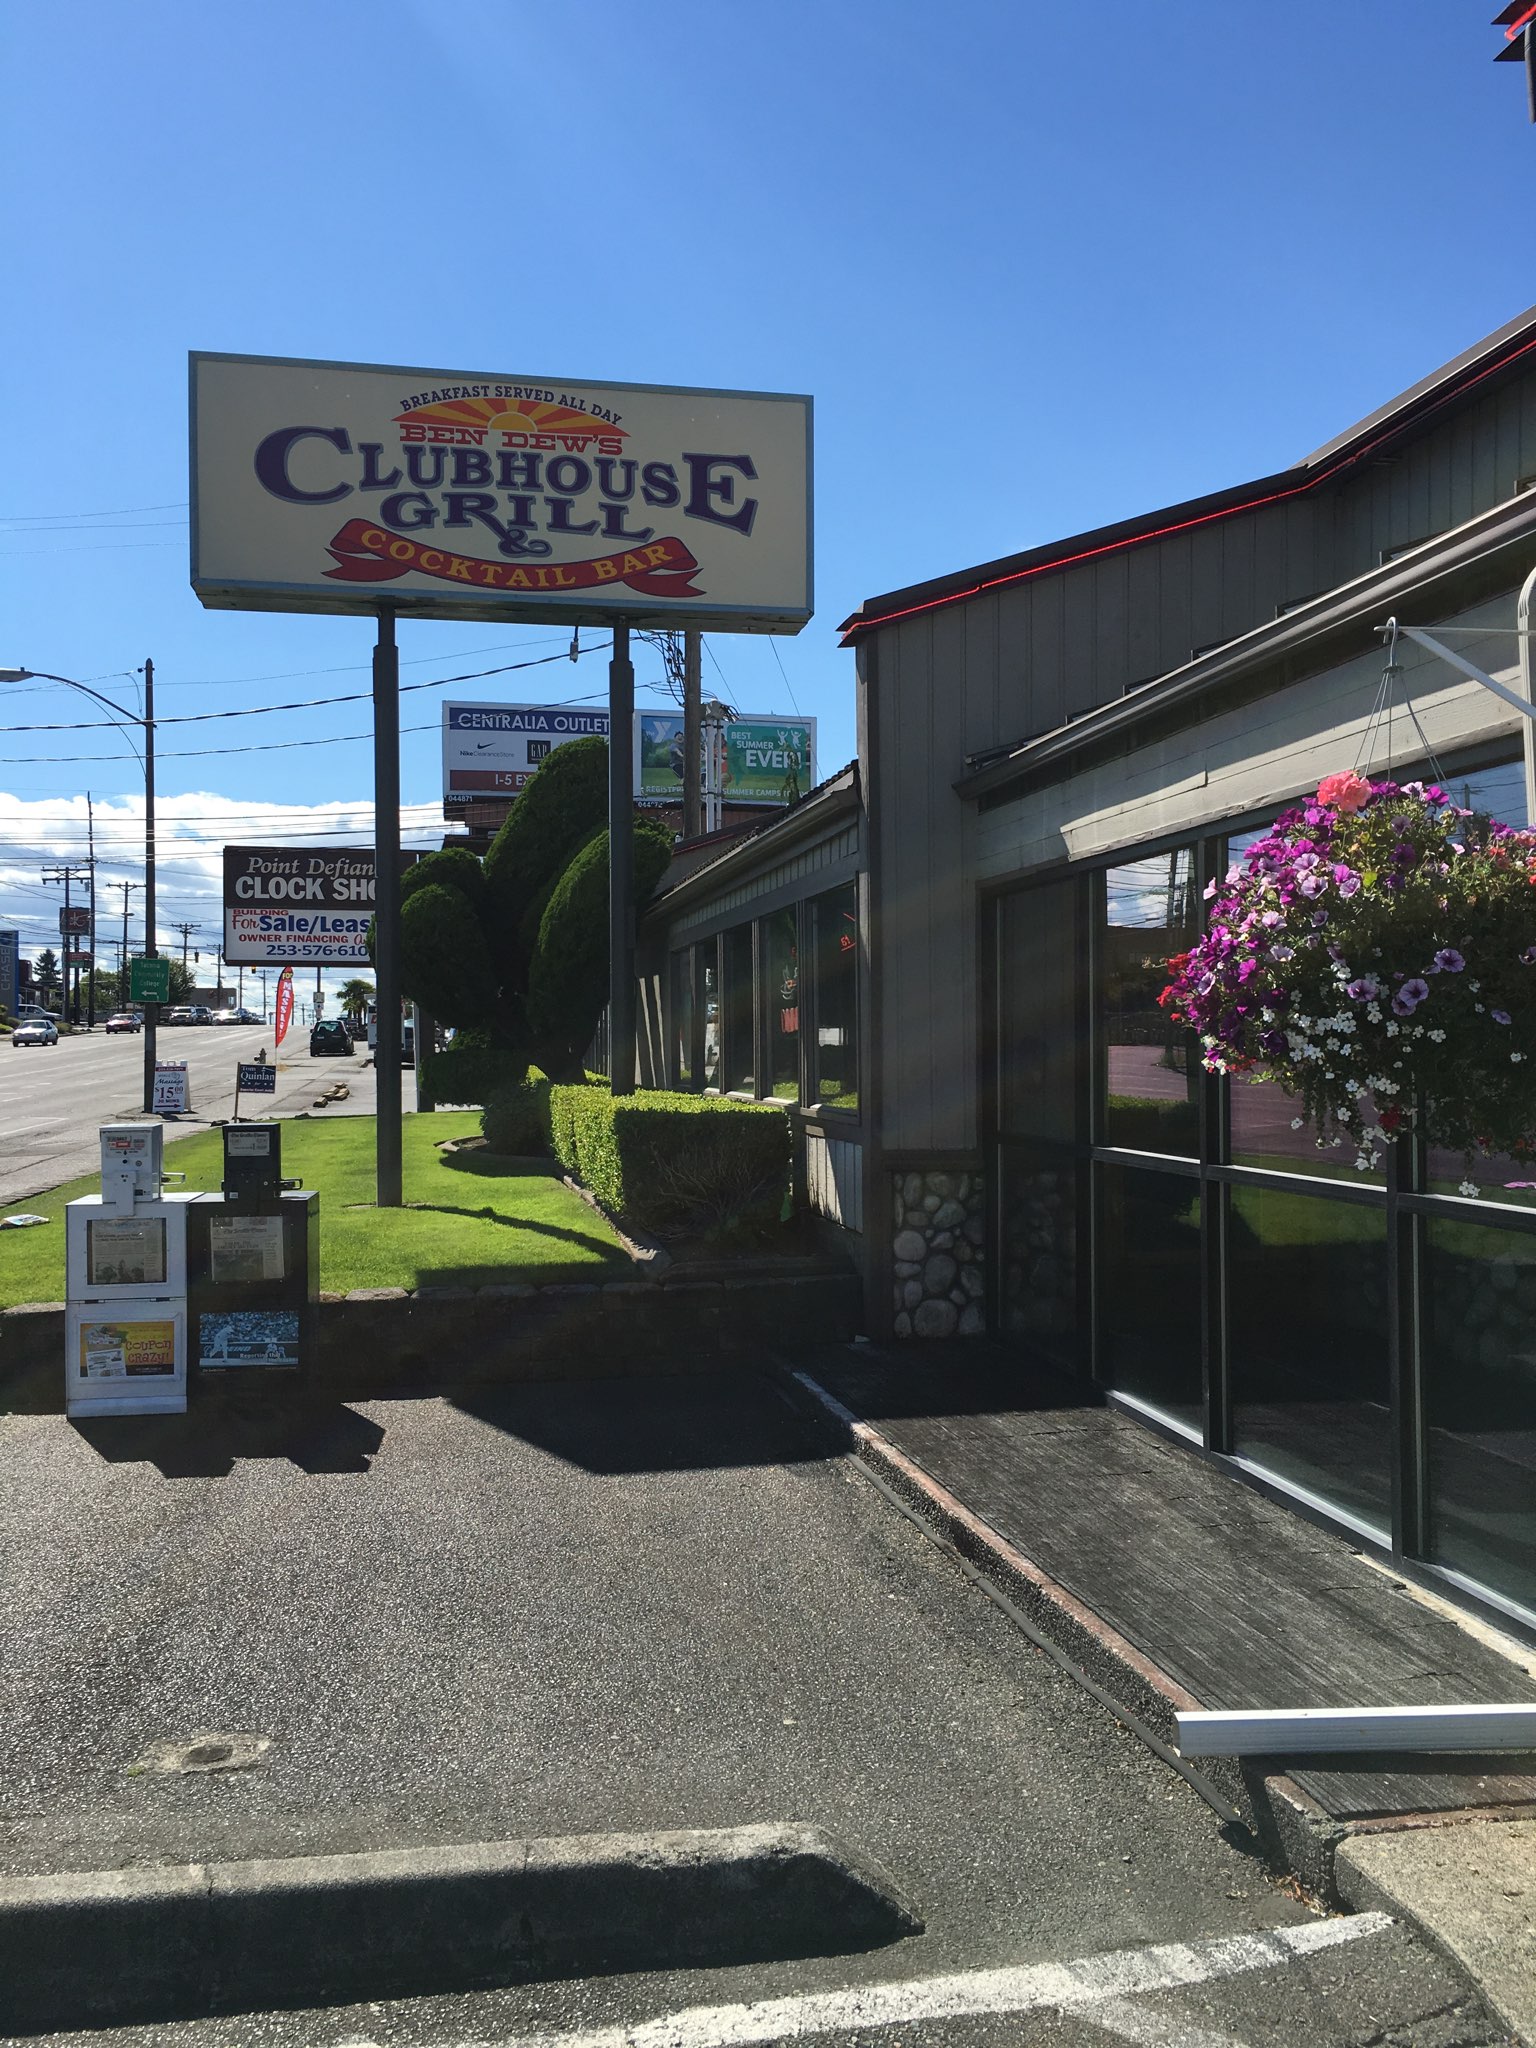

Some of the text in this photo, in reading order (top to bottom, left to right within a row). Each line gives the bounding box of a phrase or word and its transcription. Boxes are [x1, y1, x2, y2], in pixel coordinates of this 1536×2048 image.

[400, 385, 622, 426] BREAKFAST SERVED ALL DAY
[400, 423, 623, 456] BEN DEW'S
[253, 425, 759, 537] CLUBHOUSE
[380, 491, 655, 544] GRILL
[497, 528, 553, 558] &
[360, 528, 674, 588] COCKTAIL BAR
[458, 712, 609, 732] CENTRALIA OUTLET
[731, 731, 752, 740] BEST
[736, 740, 774, 750] SUMMER
[530, 743, 548, 758] GAP
[495, 773, 532, 786] I-5 EX
[723, 787, 755, 796] SUMMER
[756, 789, 781, 797] CAMPS
[246, 856, 375, 880] Point Defian
[235, 875, 376, 901] CLOCK SH
[231, 914, 371, 935] For Sale/Leas
[238, 933, 282, 943] OWNER
[286, 934, 348, 944] FINANCING
[266, 944, 369, 956] 253·576·610
[1, 947, 11, 990] CHASE
[240, 1071, 276, 1082] Quinlan
